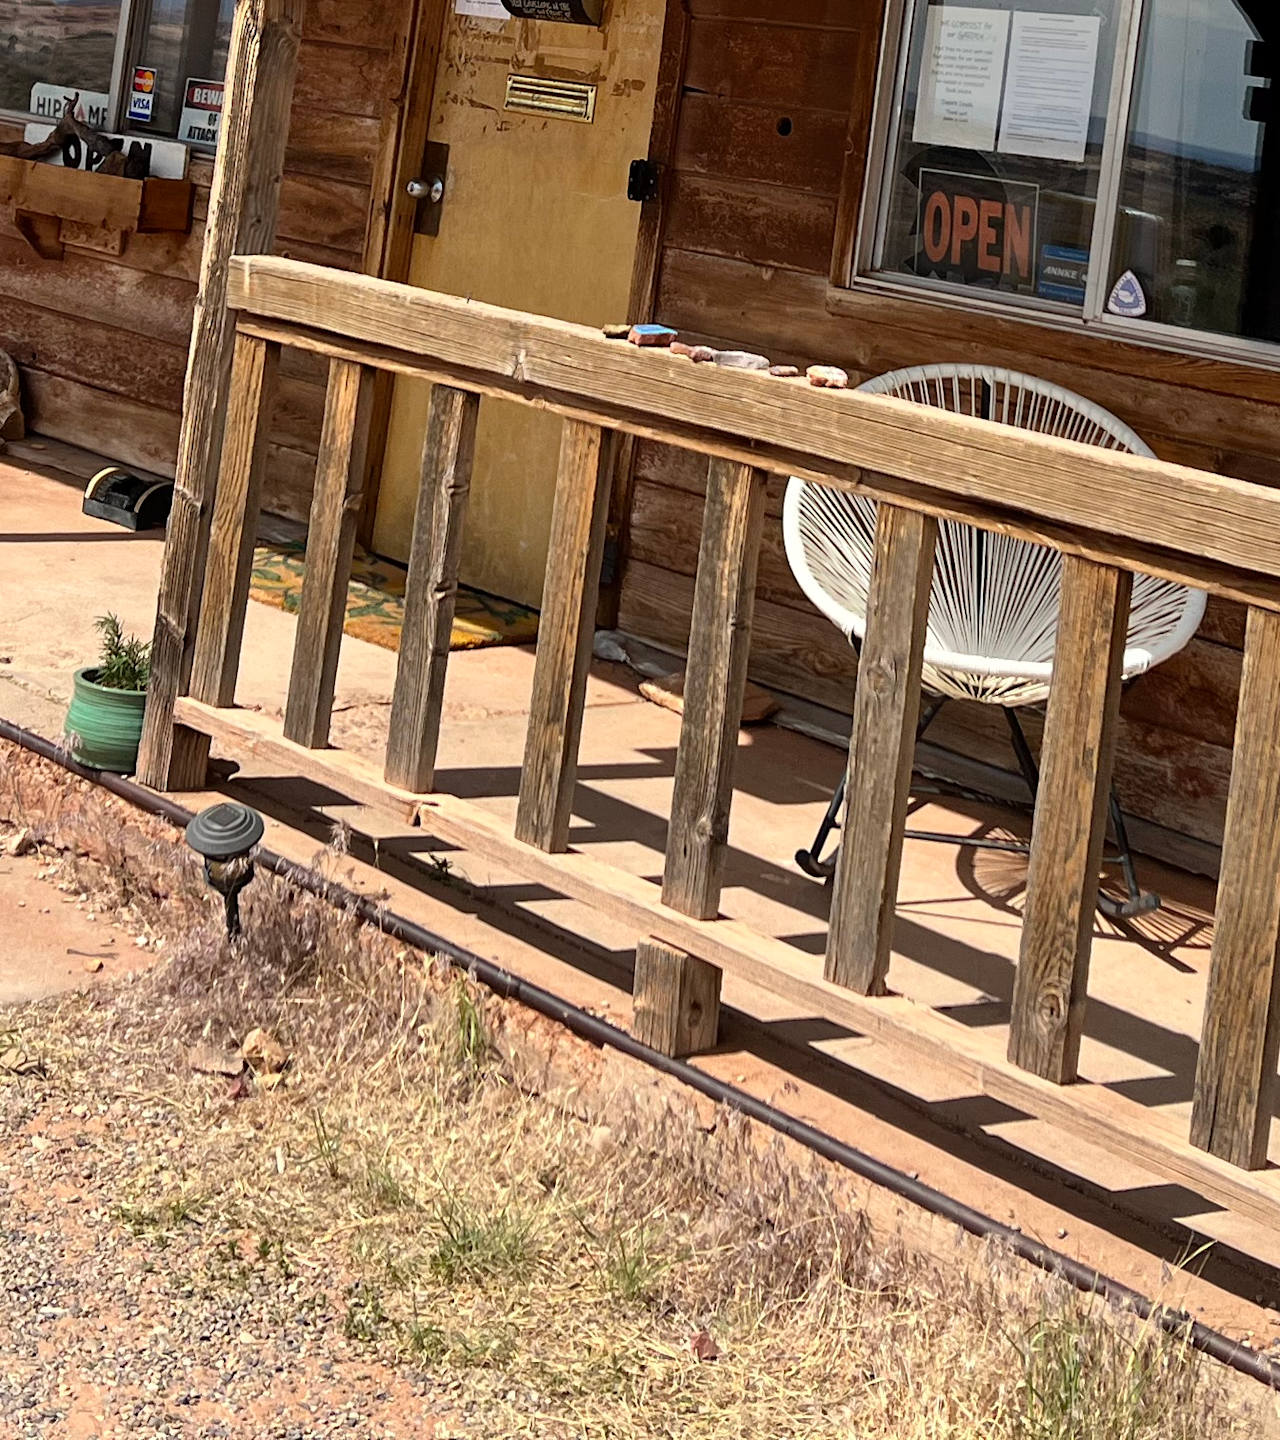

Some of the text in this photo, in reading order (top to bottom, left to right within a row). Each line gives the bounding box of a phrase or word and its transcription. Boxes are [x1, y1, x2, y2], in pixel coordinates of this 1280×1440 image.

[132, 98, 151, 111] VISA
[193, 87, 224, 106] BEWA
[923, 190, 1032, 278] OPEN
[1043, 266, 1078, 280] ANNKE
